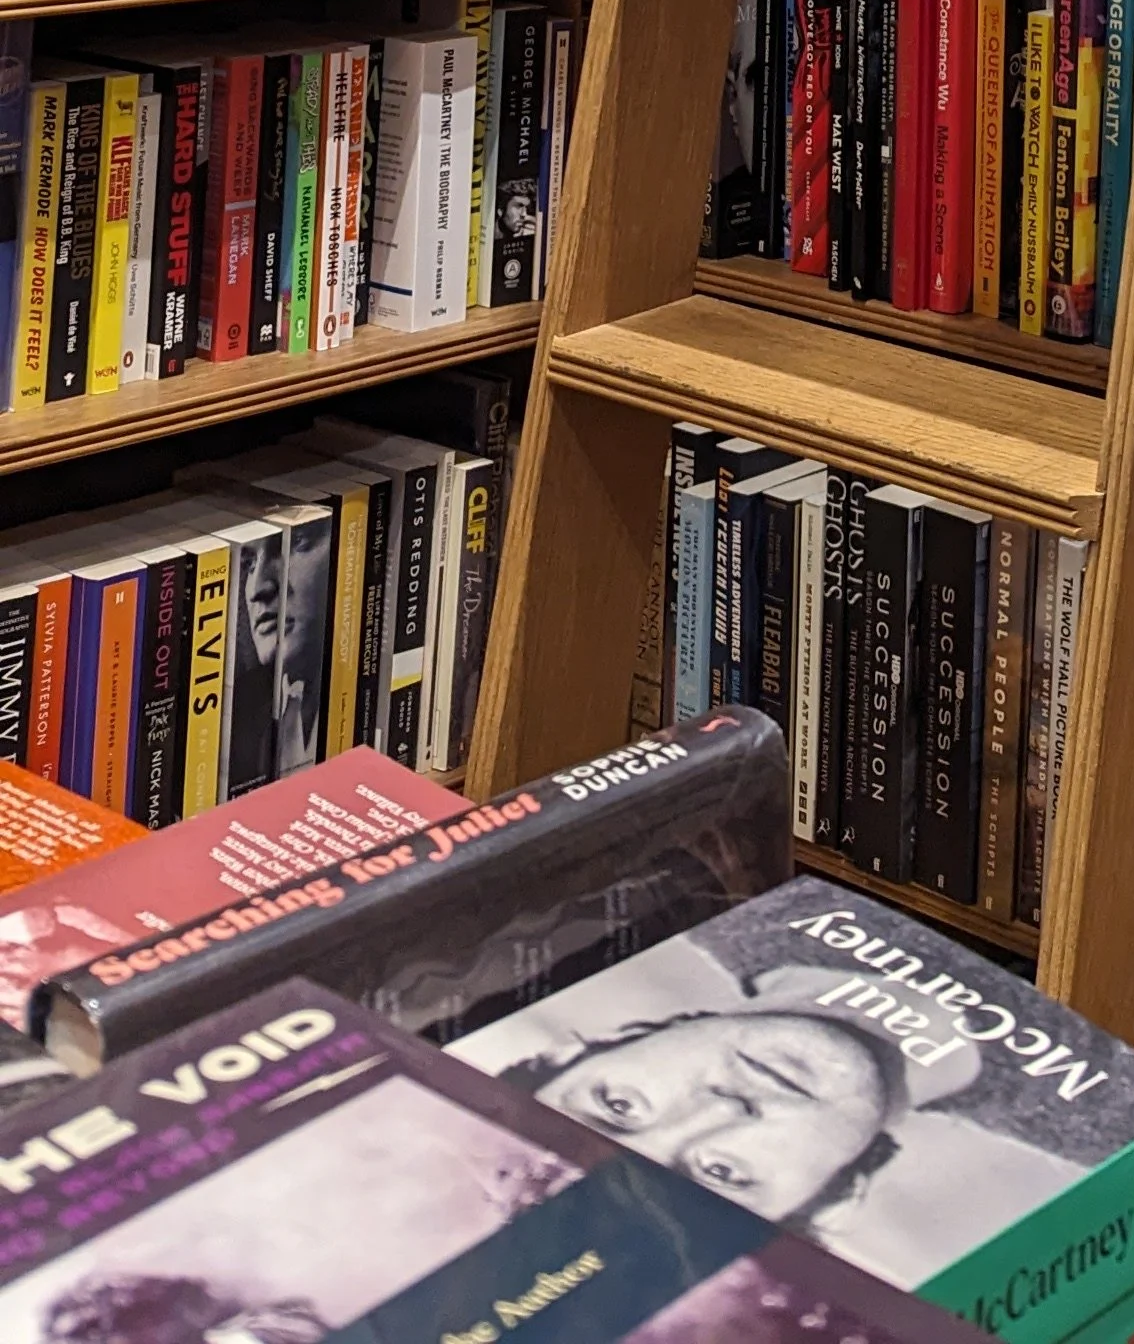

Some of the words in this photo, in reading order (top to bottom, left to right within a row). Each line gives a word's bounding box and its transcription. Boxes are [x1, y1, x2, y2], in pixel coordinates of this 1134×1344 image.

[173, 89, 198, 183] HARD
[1053, 123, 1073, 195] Fenton
[167, 190, 196, 288] STUFF
[1051, 199, 1071, 279] Bailey
[199, 564, 227, 581] BEING
[193, 582, 226, 717] ELVIS
[871, 571, 893, 802] SUCCESSION
[551, 736, 662, 788] SOPHIE
[561, 743, 690, 803] DUNCAN
[89, 873, 346, 988] Searching
[341, 842, 418, 888] for
[426, 792, 542, 864] Juliet
[787, 910, 1109, 1104] McCartney
[815, 976, 967, 1069] Paul
[139, 1007, 338, 1107] VOID
